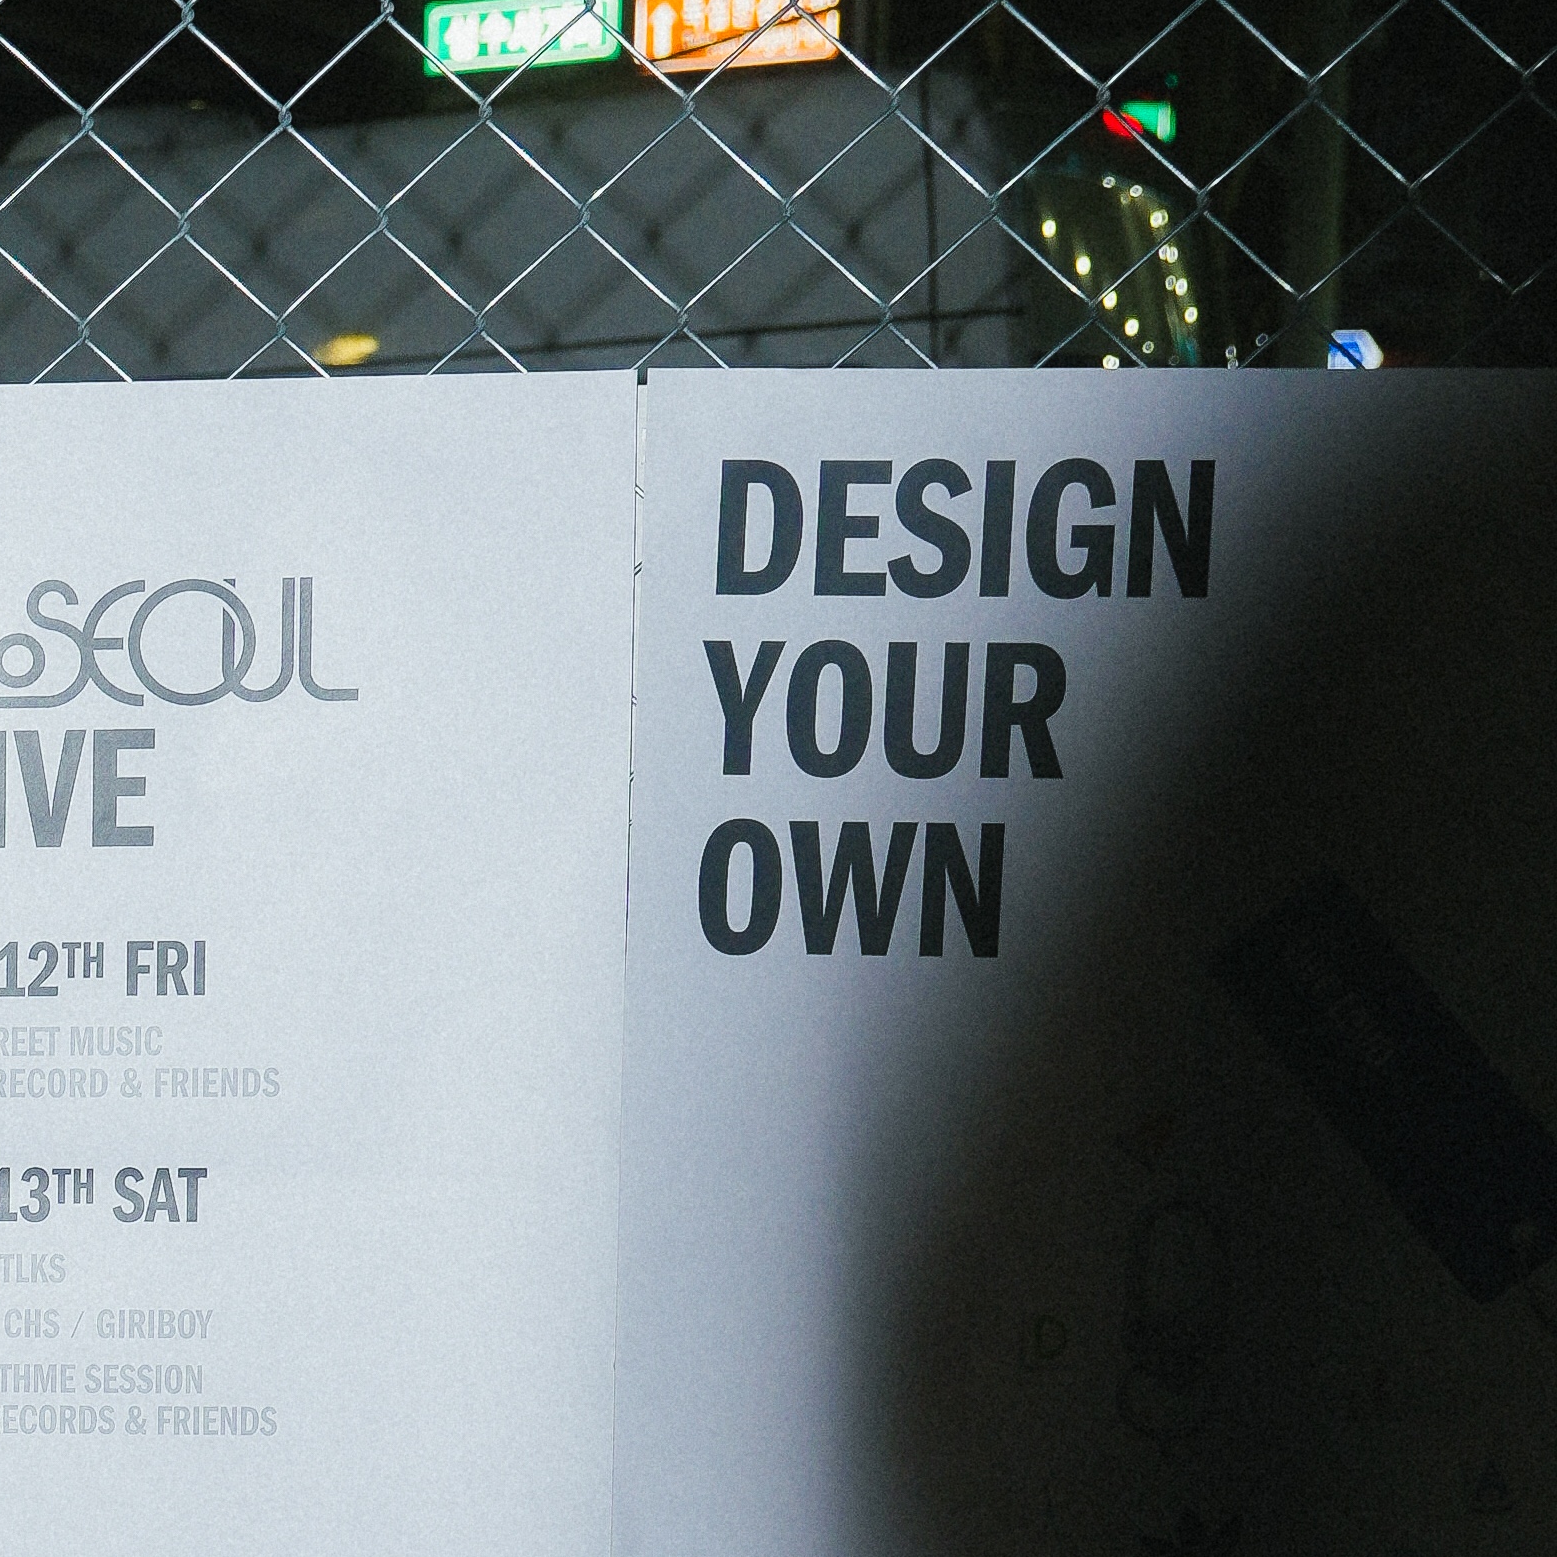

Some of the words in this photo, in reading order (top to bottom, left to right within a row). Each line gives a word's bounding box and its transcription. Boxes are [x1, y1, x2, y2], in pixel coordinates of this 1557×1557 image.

[715, 458, 1216, 599] DESIGN
[702, 639, 1068, 780] YOUR
[697, 818, 1006, 959] OWN
[127, 941, 205, 996] FRI
[70, 1026, 162, 1056] MUSIC
[120, 1068, 142, 1098] &
[155, 1067, 280, 1098] FRIENDS
[114, 1167, 207, 1222] SAT
[0, 1254, 66, 1283] TLKS
[5, 1309, 59, 1339] CHS
[97, 1309, 213, 1339] GIRIBOY
[85, 1364, 202, 1394] SESSION
[125, 1406, 147, 1435] &
[157, 1406, 277, 1436] FRIENDS
